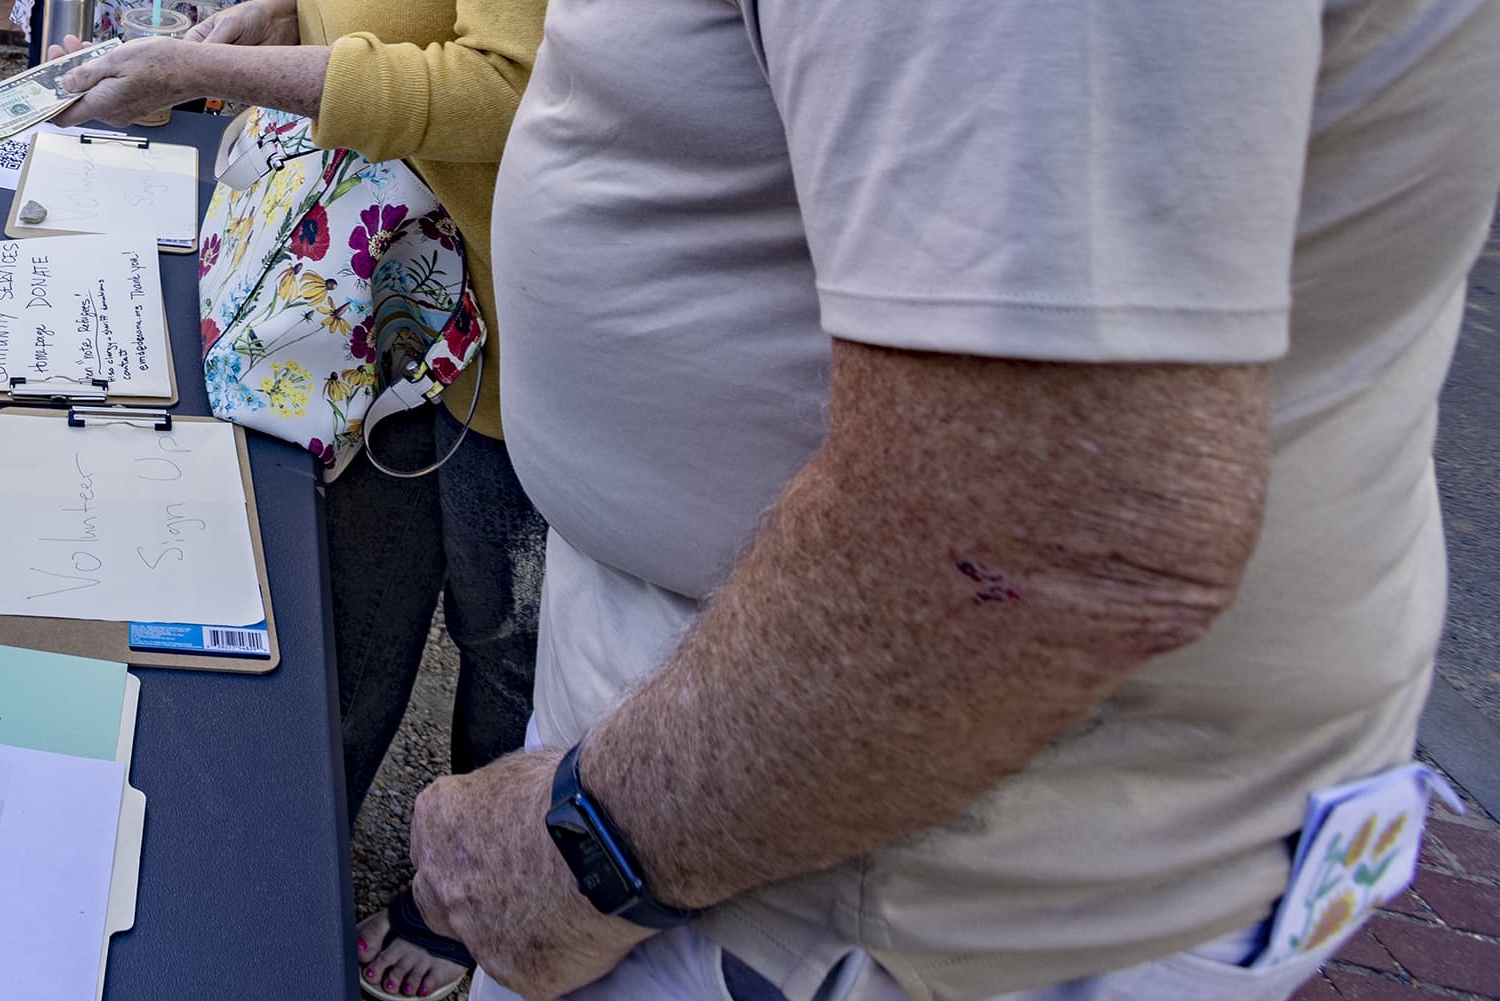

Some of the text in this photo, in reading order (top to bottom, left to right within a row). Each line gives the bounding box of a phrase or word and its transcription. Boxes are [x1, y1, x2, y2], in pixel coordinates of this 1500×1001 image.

[25, 256, 52, 309] DONATE
[127, 274, 146, 300] Thank
[26, 452, 102, 600] Volunteer
[137, 502, 206, 569] Sign
